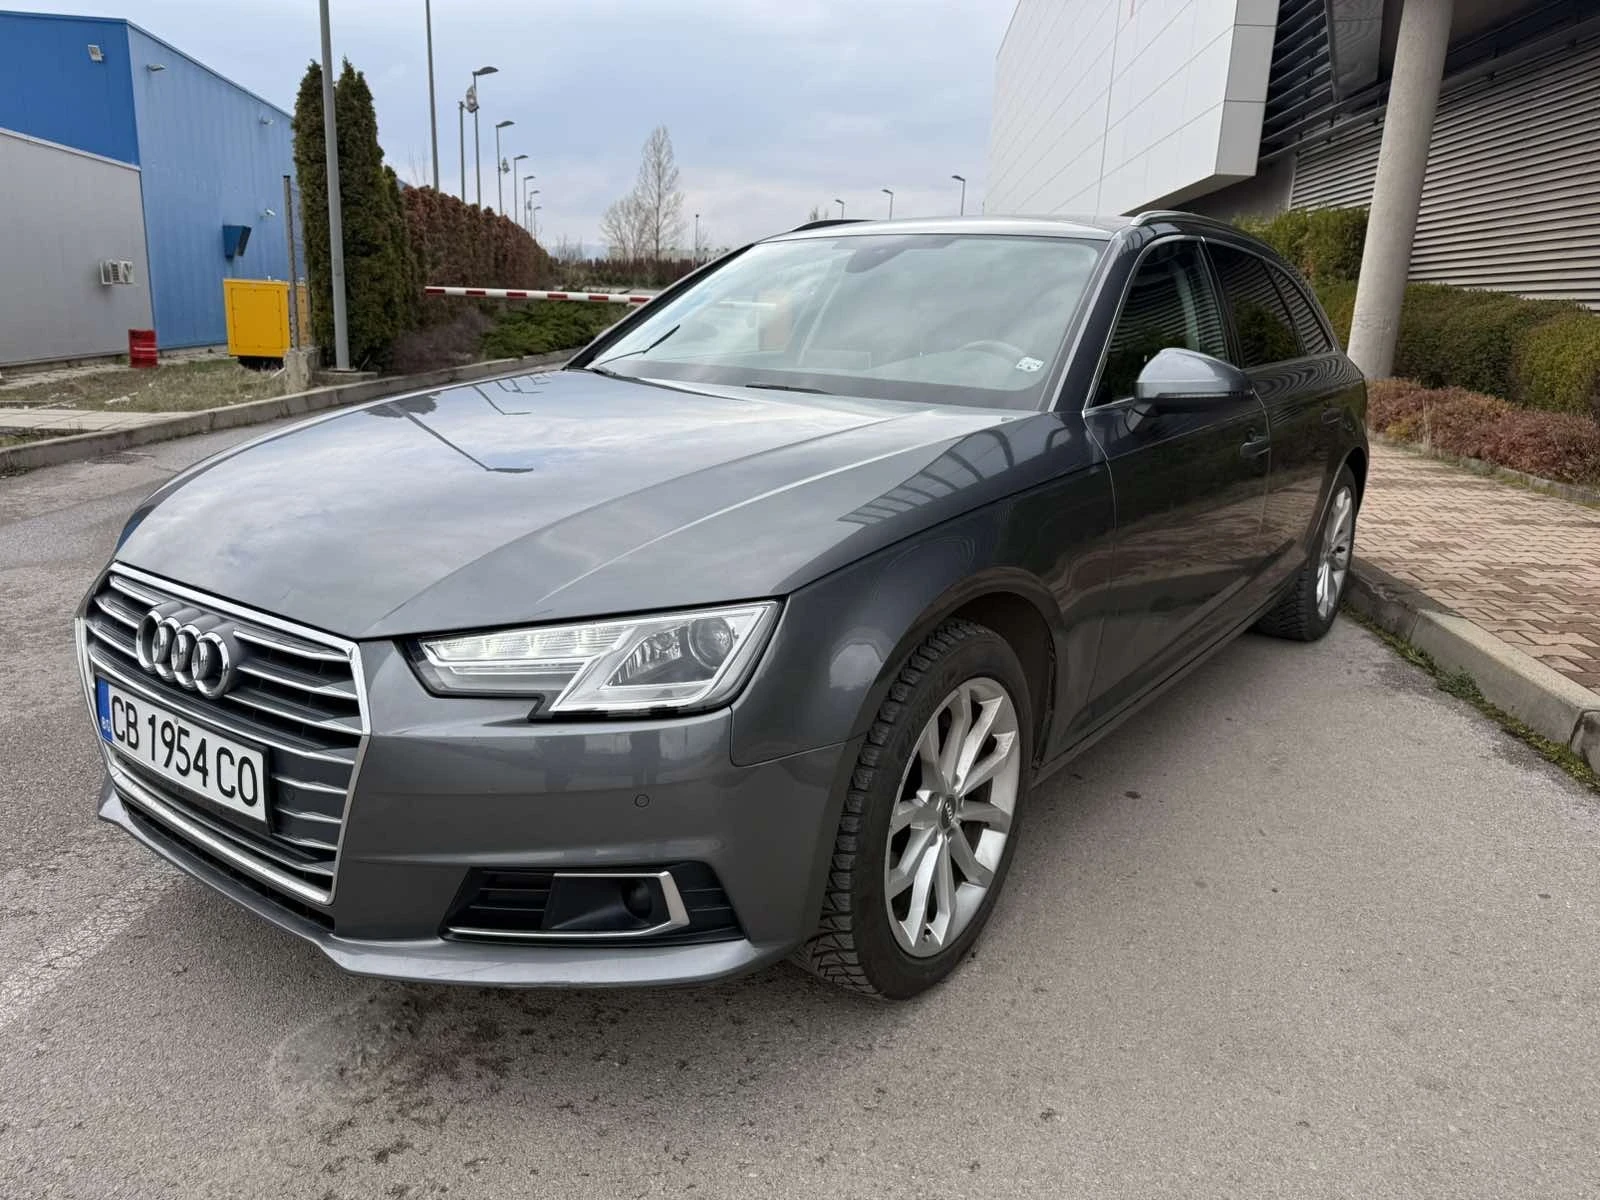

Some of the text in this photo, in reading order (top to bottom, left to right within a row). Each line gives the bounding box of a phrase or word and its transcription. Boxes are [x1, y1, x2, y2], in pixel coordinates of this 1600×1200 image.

[111, 695, 258, 807] CB 1954 CO
